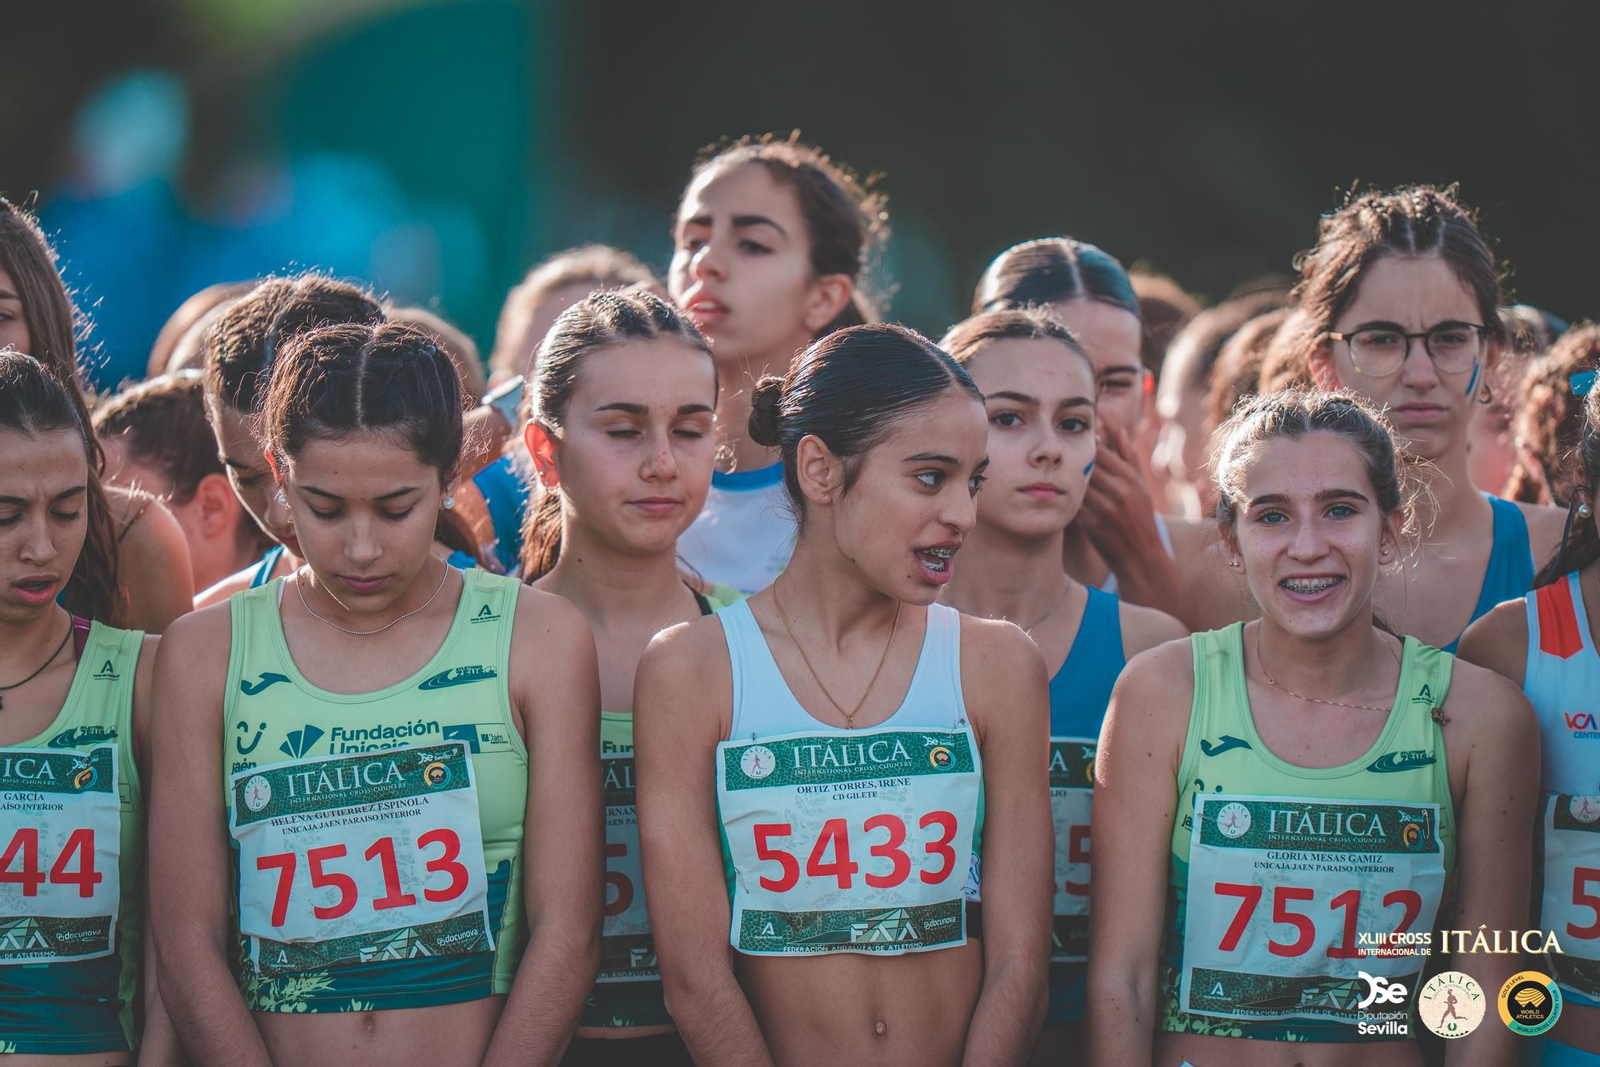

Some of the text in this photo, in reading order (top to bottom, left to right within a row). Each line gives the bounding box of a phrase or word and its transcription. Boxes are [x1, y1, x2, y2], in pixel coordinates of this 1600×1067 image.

[331, 719, 440, 741] Fundación
[791, 739, 912, 769] ITÁLICA
[794, 768, 852, 777] INTERNATIONAL
[879, 761, 913, 769] COUNTRY
[287, 760, 405, 797] ITÁLICA
[797, 778, 911, 794] ORTIZ TORRES, IRENE
[289, 782, 407, 804] INTERNATIONAL CROSS COUNTRY
[832, 791, 878, 801] CD GILETE
[0, 802, 64, 811] AÍSO INTERIOR
[271, 797, 429, 826] HELENA GUTIERREZ ESPINOLA
[282, 808, 421, 835] UNICAJA JAEN PARAISO INTERIOR
[1268, 805, 1386, 836] ITÁLICA
[1268, 834, 1326, 842] INTERNATIONAL
[753, 810, 958, 893] 5433
[1267, 851, 1383, 863] GLORIA MESAS GAMIZ
[1254, 861, 1290, 870] UNICAJA
[1316, 864, 1353, 872] PARAISO
[256, 828, 469, 927] 7513
[929, 916, 956, 928] docunova
[1214, 882, 1423, 959] 7512
[64, 929, 102, 940] docunova
[444, 928, 479, 943] docunova
[783, 945, 828, 953] FEDERACIÓN
[888, 941, 923, 951] ATLETISMO
[1232, 1008, 1278, 1016] FEDERACIÓN
